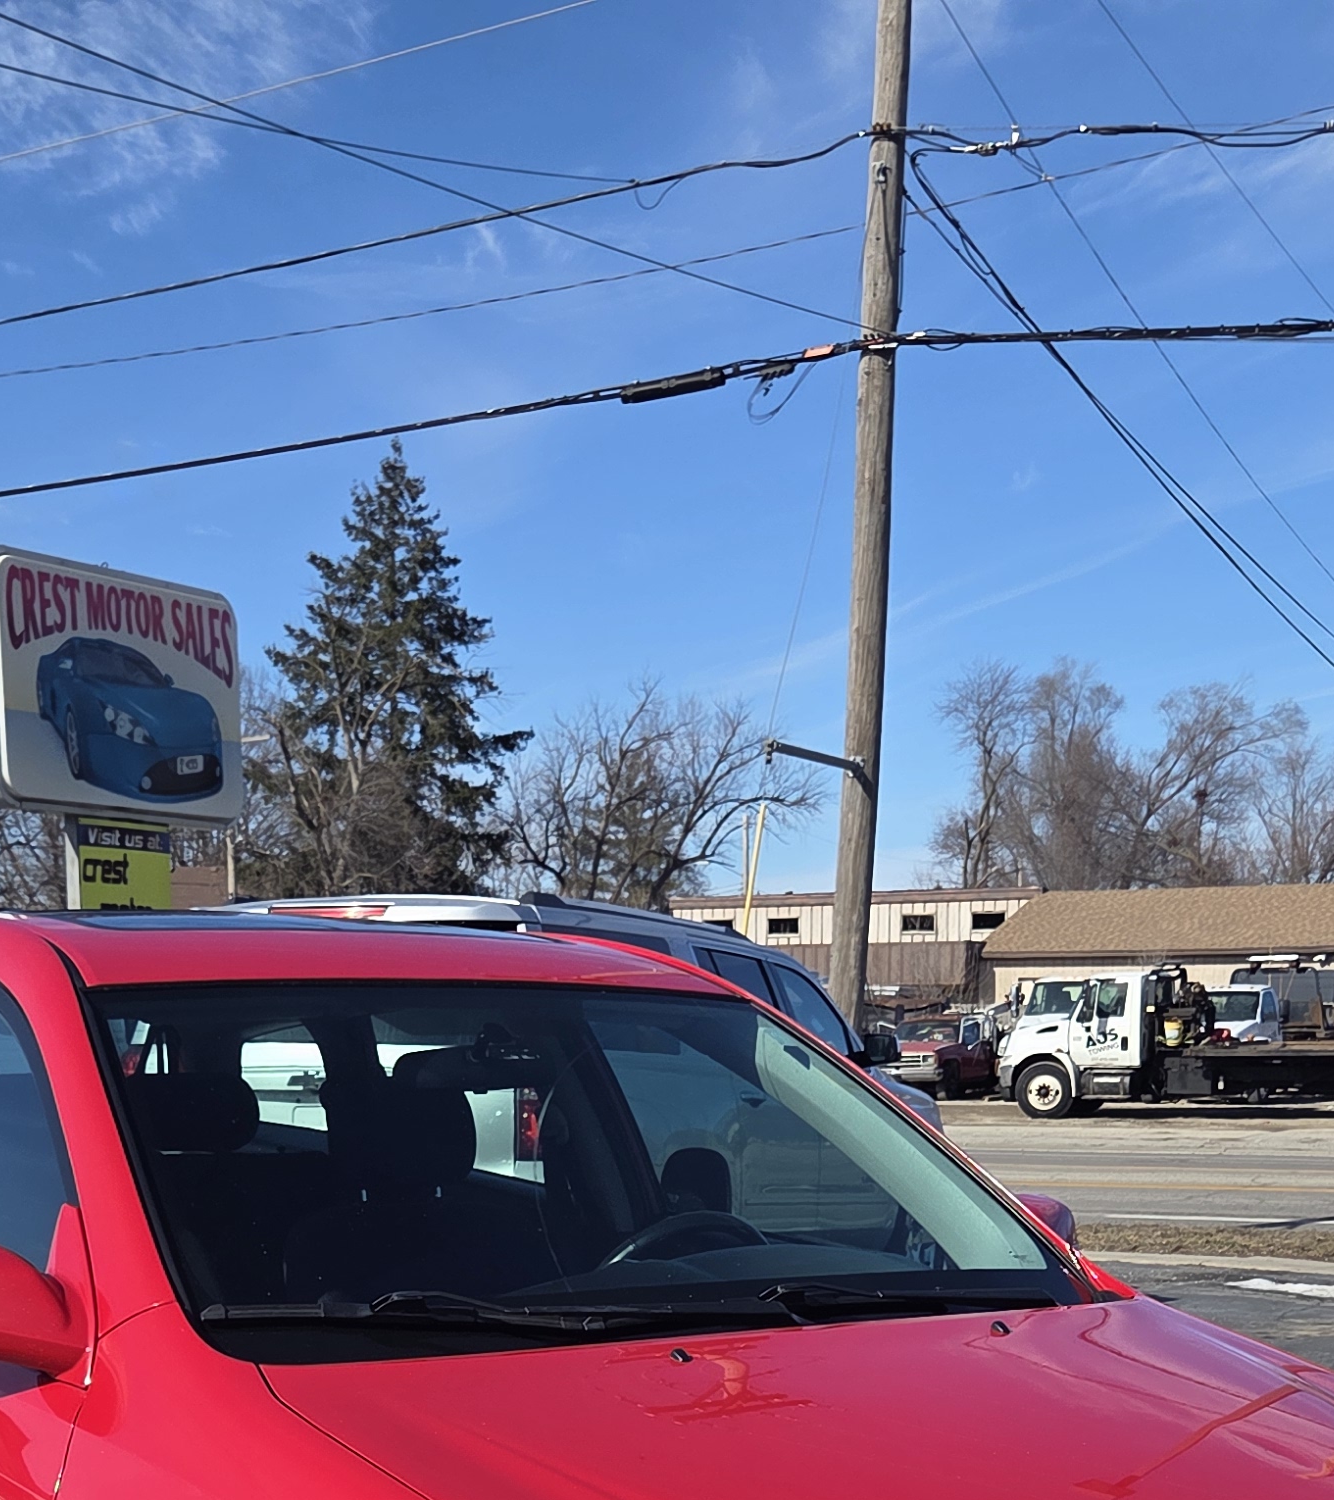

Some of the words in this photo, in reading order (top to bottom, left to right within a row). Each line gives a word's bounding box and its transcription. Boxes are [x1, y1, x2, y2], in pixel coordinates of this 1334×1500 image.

[5, 564, 80, 650] CREST
[85, 581, 168, 646] MOTOR
[170, 599, 234, 689] SALES
[88, 828, 121, 846] Visit
[125, 834, 144, 848] us
[82, 853, 129, 885] crest
